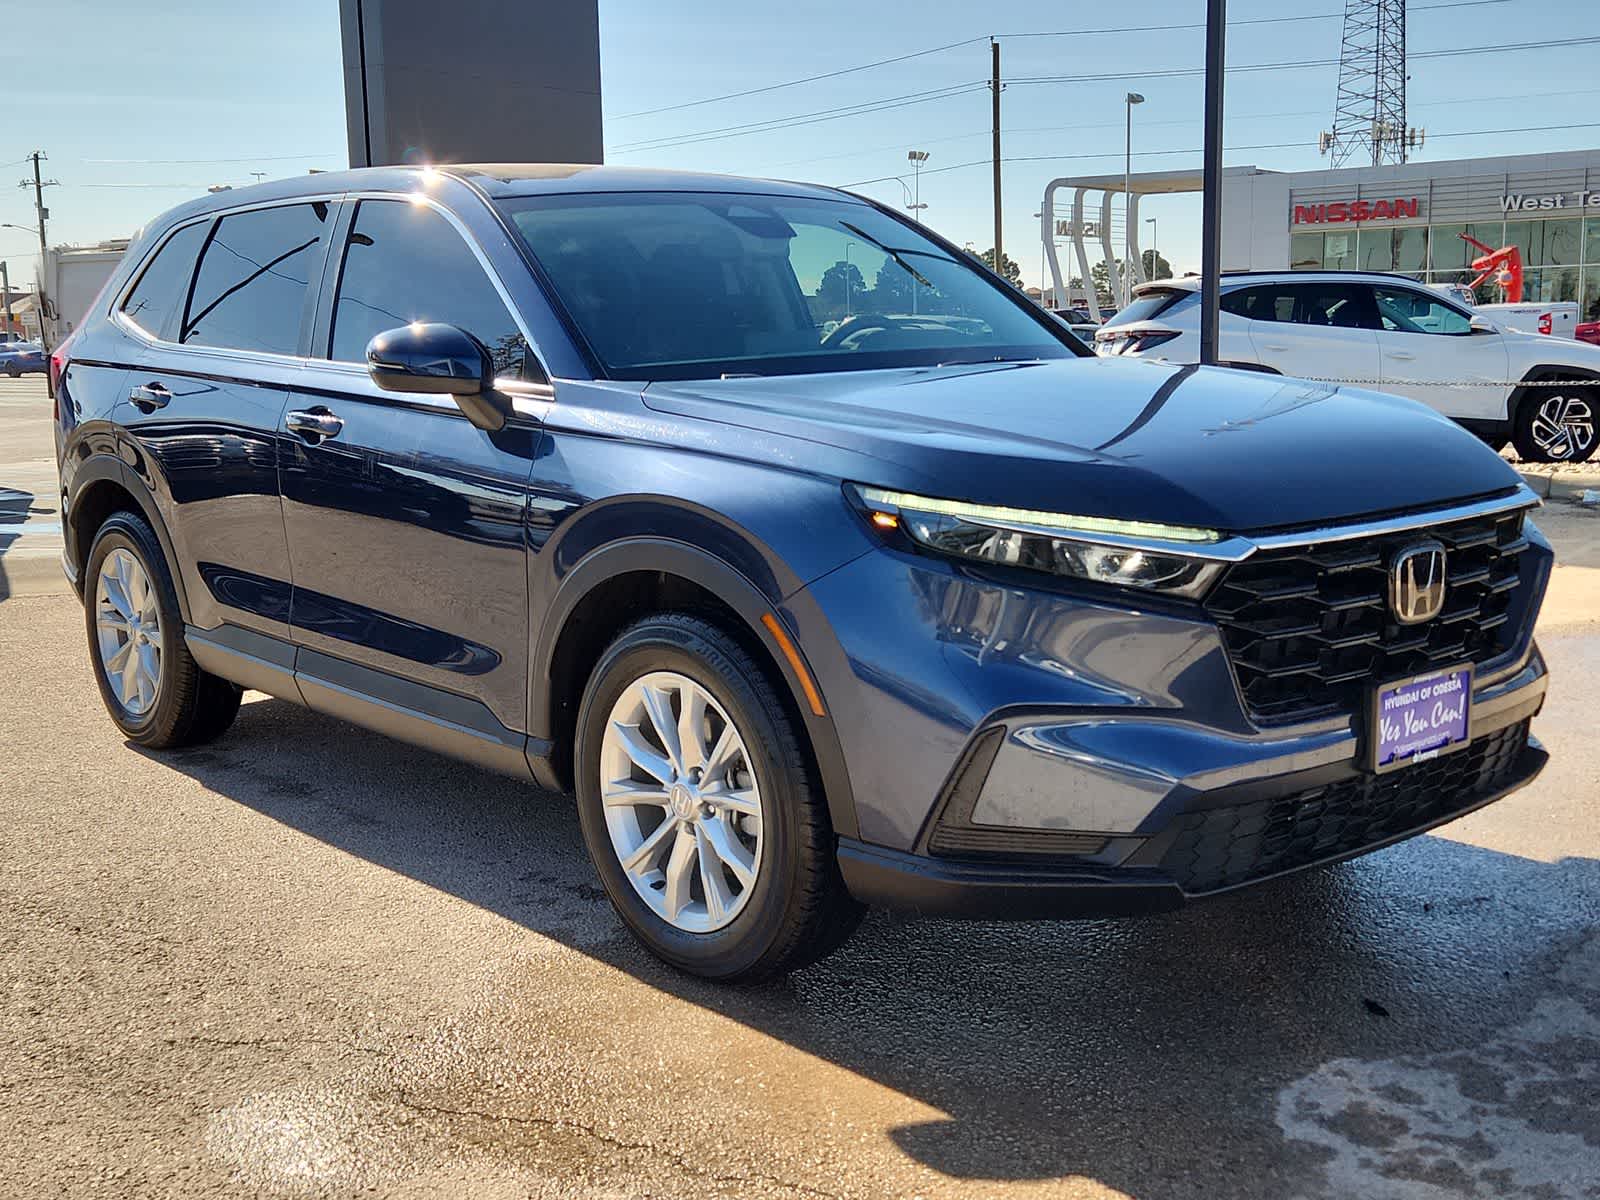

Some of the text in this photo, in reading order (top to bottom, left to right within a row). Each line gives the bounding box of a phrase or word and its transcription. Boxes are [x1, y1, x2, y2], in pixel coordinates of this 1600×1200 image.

[1294, 195, 1418, 225] NISSAN
[1499, 190, 1600, 212] West Te
[1384, 679, 1462, 711] HYUNDAI OF ODESSA
[1380, 716, 1401, 745] Yes
[1404, 708, 1429, 737] You
[1431, 693, 1465, 729] Can!
